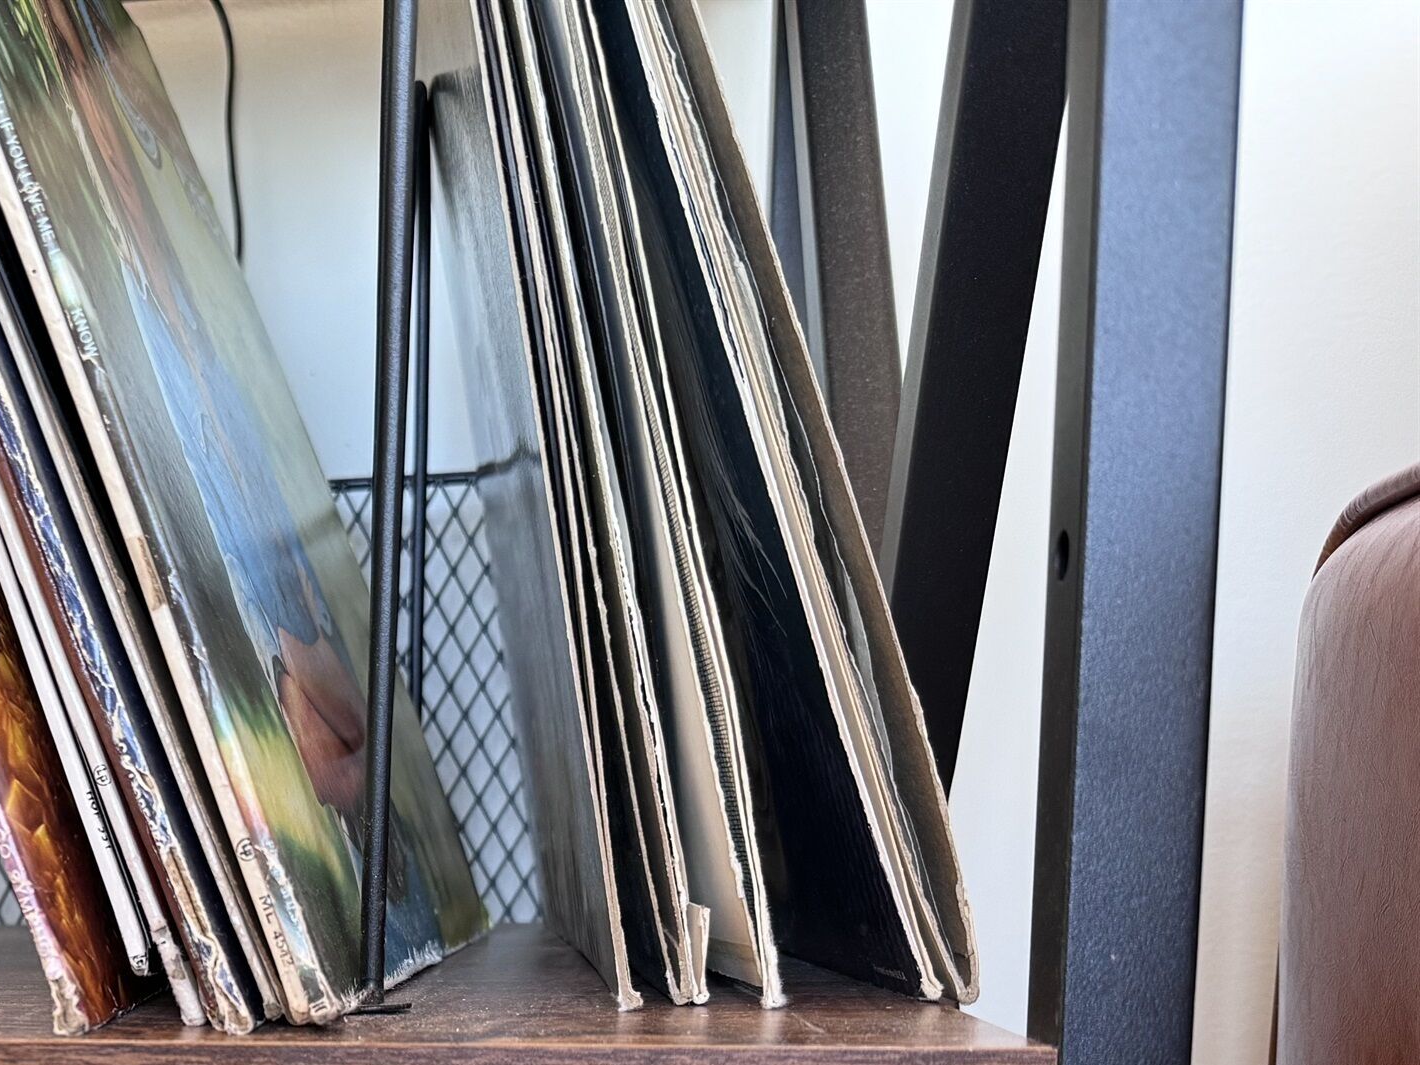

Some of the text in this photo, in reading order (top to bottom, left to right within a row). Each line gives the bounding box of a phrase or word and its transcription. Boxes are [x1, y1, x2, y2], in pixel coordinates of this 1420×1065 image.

[6, 136, 29, 171] YOU
[69, 304, 100, 358] KNOW
[258, 894, 274, 923] ML
